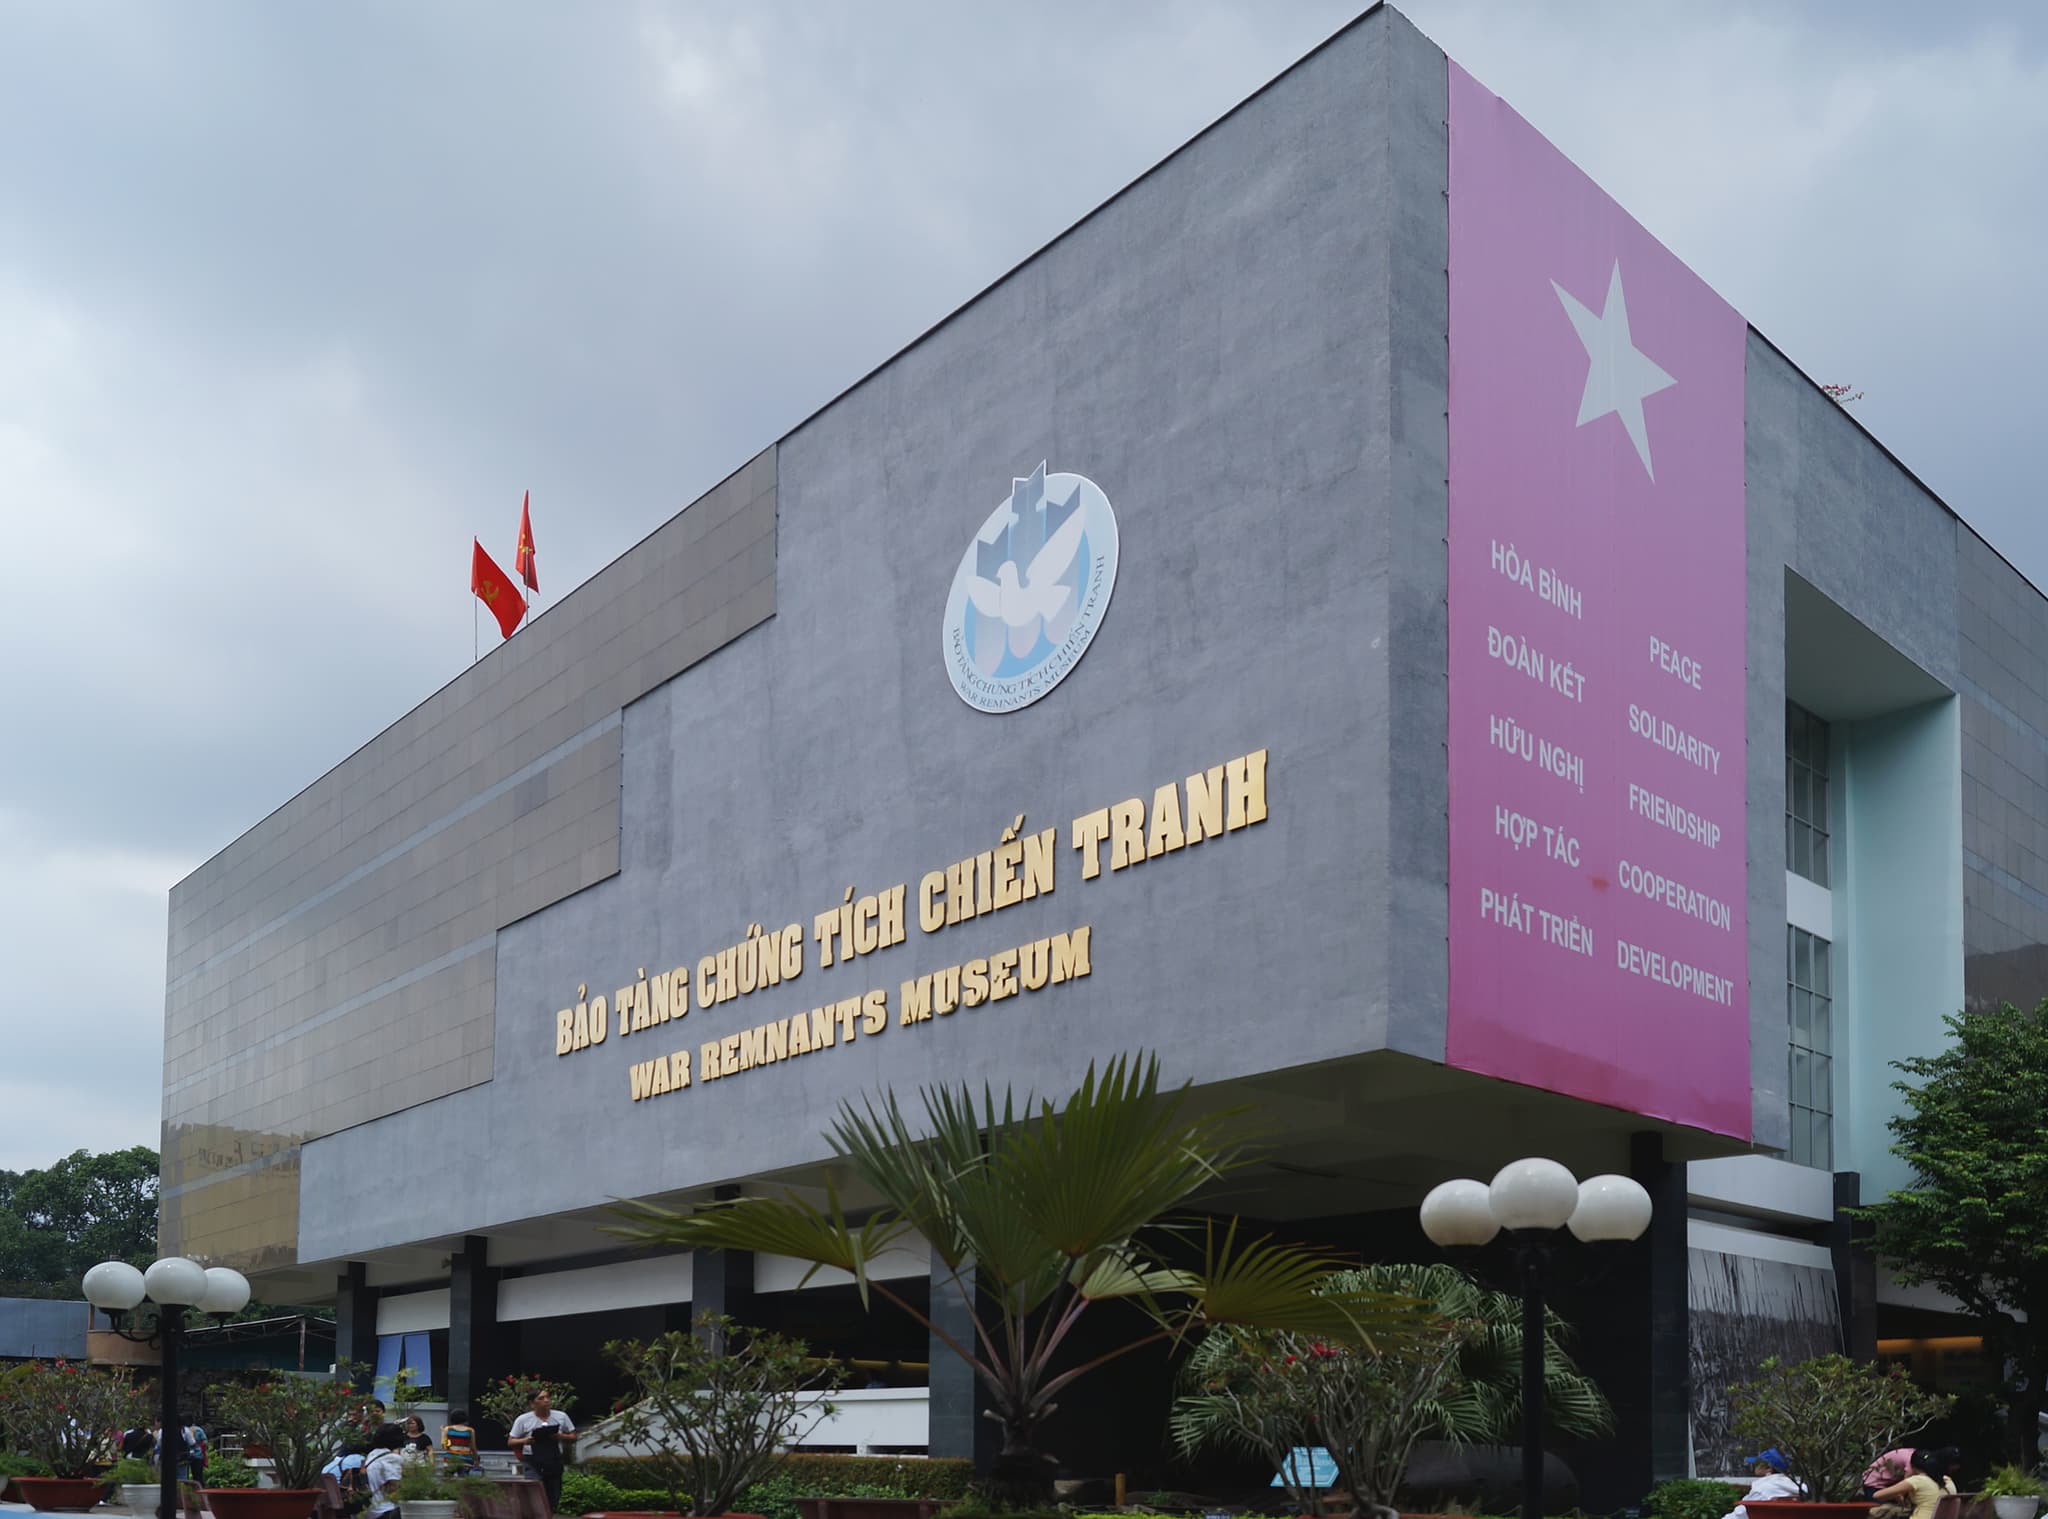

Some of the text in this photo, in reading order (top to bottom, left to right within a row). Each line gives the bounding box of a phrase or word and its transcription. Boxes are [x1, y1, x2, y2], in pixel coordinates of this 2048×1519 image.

[1492, 539, 1582, 620] HÒA BÌNH
[1488, 625, 1585, 703] ĐOÀN KẾT
[1649, 635, 1702, 691] PEACE
[1490, 714, 1584, 794] HỮU NGHỊ
[1628, 703, 1720, 775] SOLIDARITY
[1495, 805, 1580, 868] HỢP TÁC
[1629, 783, 1721, 849] FRIENDSHIP
[556, 748, 1269, 1056] BẢO TÀNG CHỨNG TÍCH CHIẾN TRANH
[1481, 887, 1593, 957] PHÁT TRIỂN
[1618, 860, 1731, 932] COOPERATION
[1616, 940, 1733, 1006] DEVELOPMENT
[629, 926, 1092, 1101] WAR REMNANTS MUSEUM
